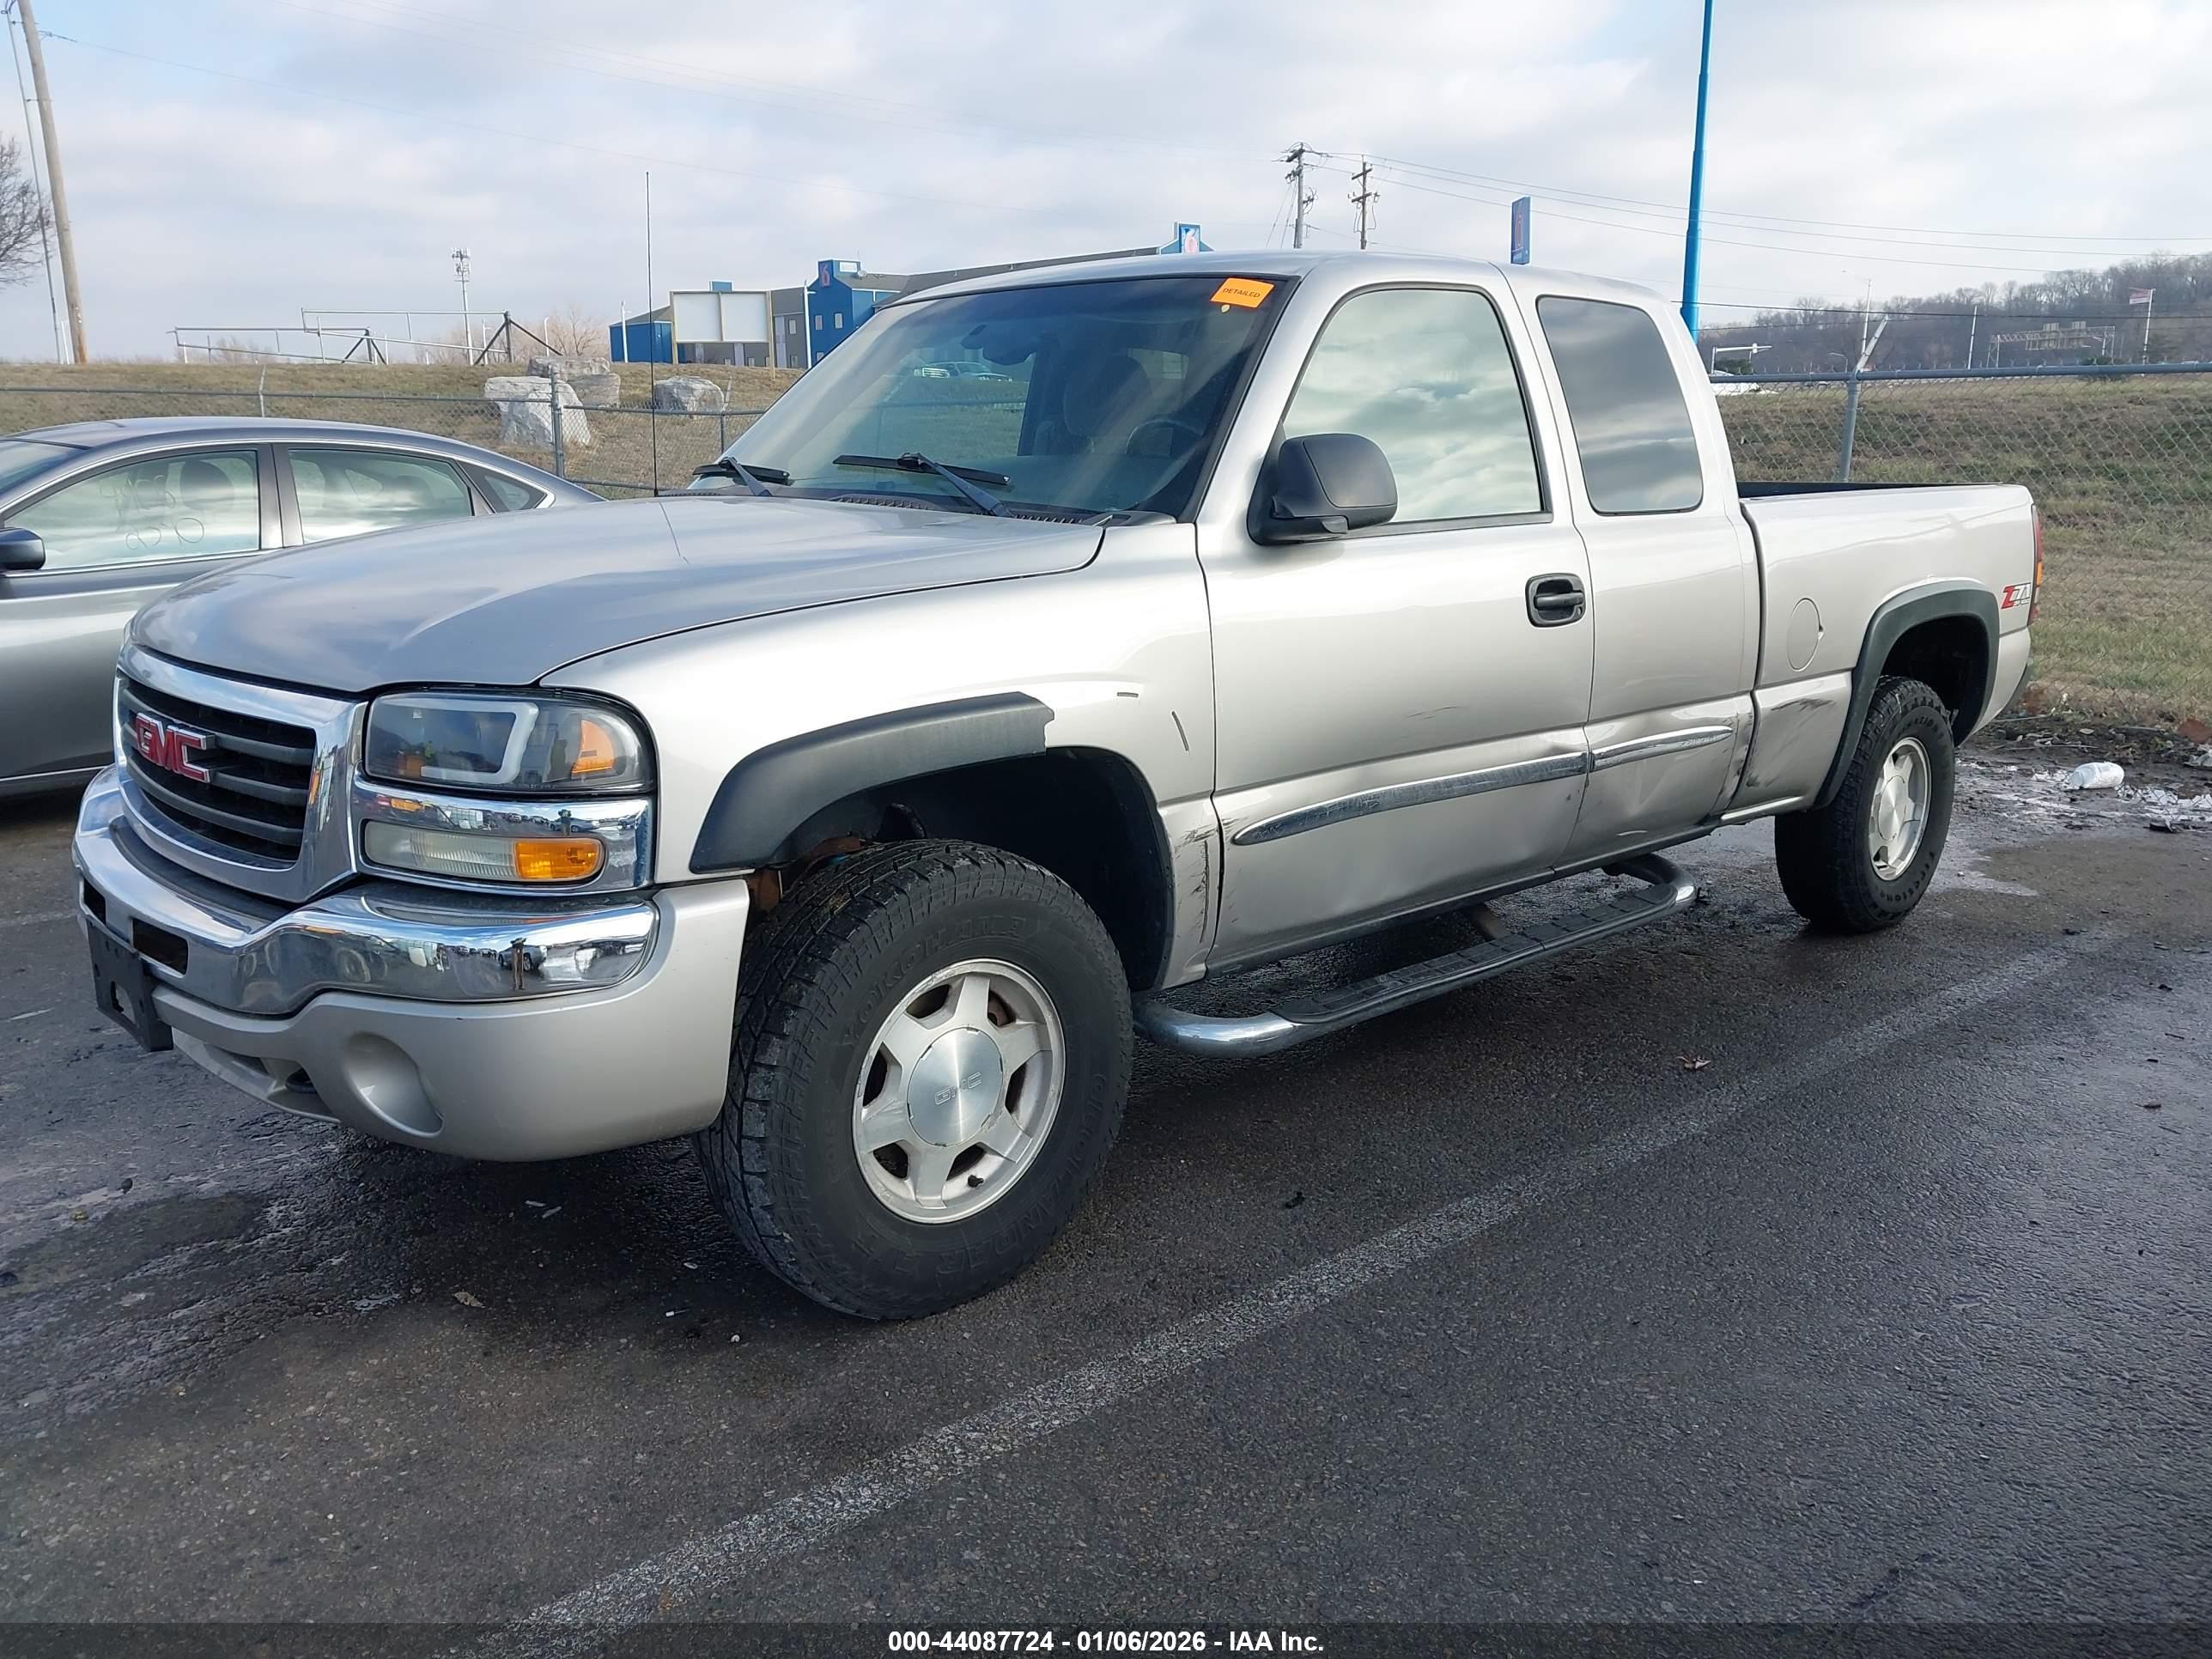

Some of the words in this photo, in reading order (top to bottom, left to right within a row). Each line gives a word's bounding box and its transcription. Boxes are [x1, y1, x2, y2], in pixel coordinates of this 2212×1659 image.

[821, 263, 831, 288] 6
[1222, 287, 1261, 299] DETAILED
[2001, 581, 2032, 610] Z71
[136, 712, 211, 783] GMC
[933, 1071, 982, 1106] GMC
